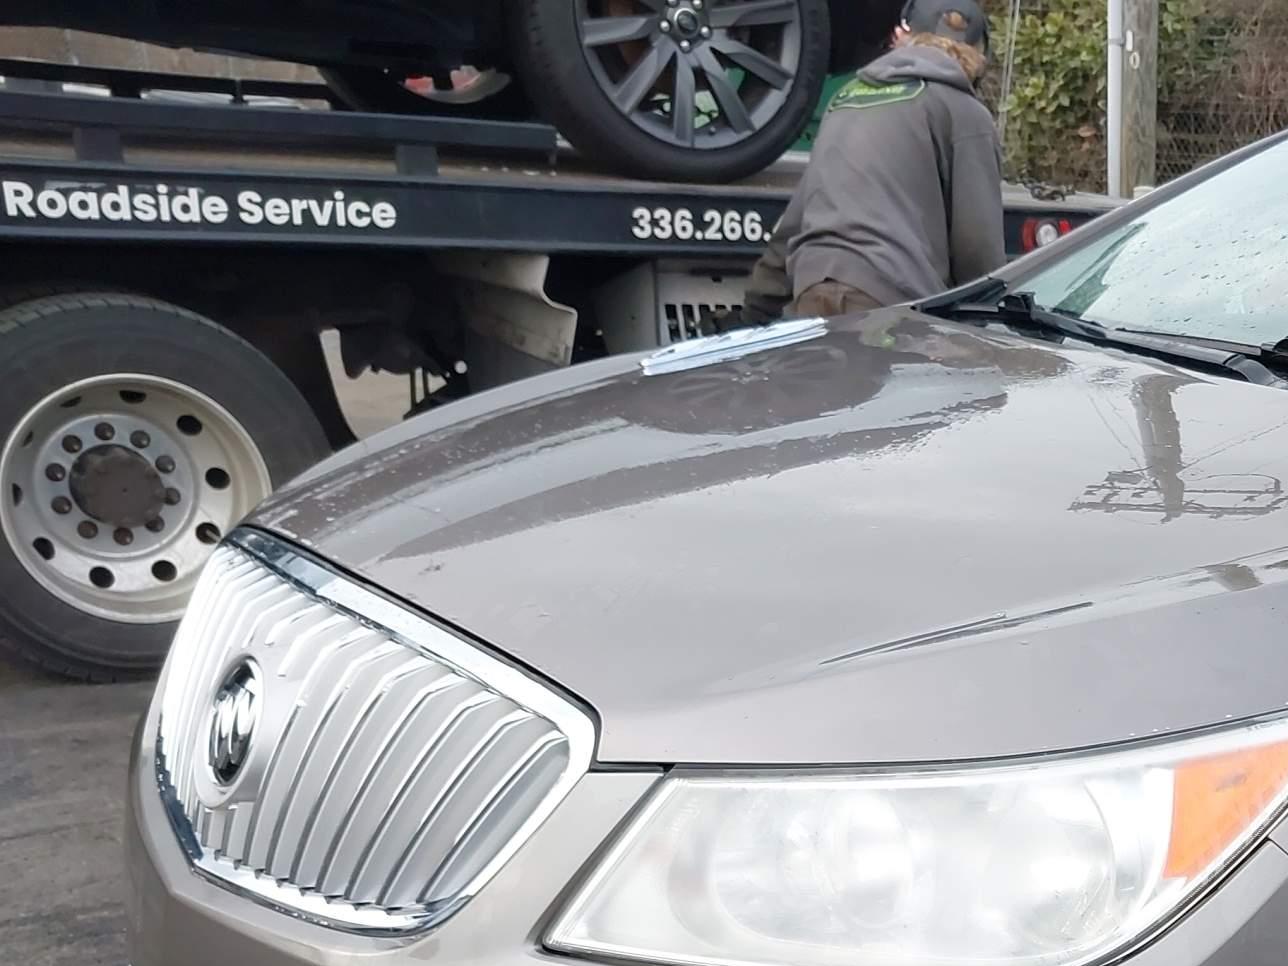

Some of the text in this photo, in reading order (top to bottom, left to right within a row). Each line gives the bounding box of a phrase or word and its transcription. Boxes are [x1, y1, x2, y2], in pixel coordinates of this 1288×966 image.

[1, 180, 397, 229] Roadside Service
[631, 206, 783, 242] 336.266.
